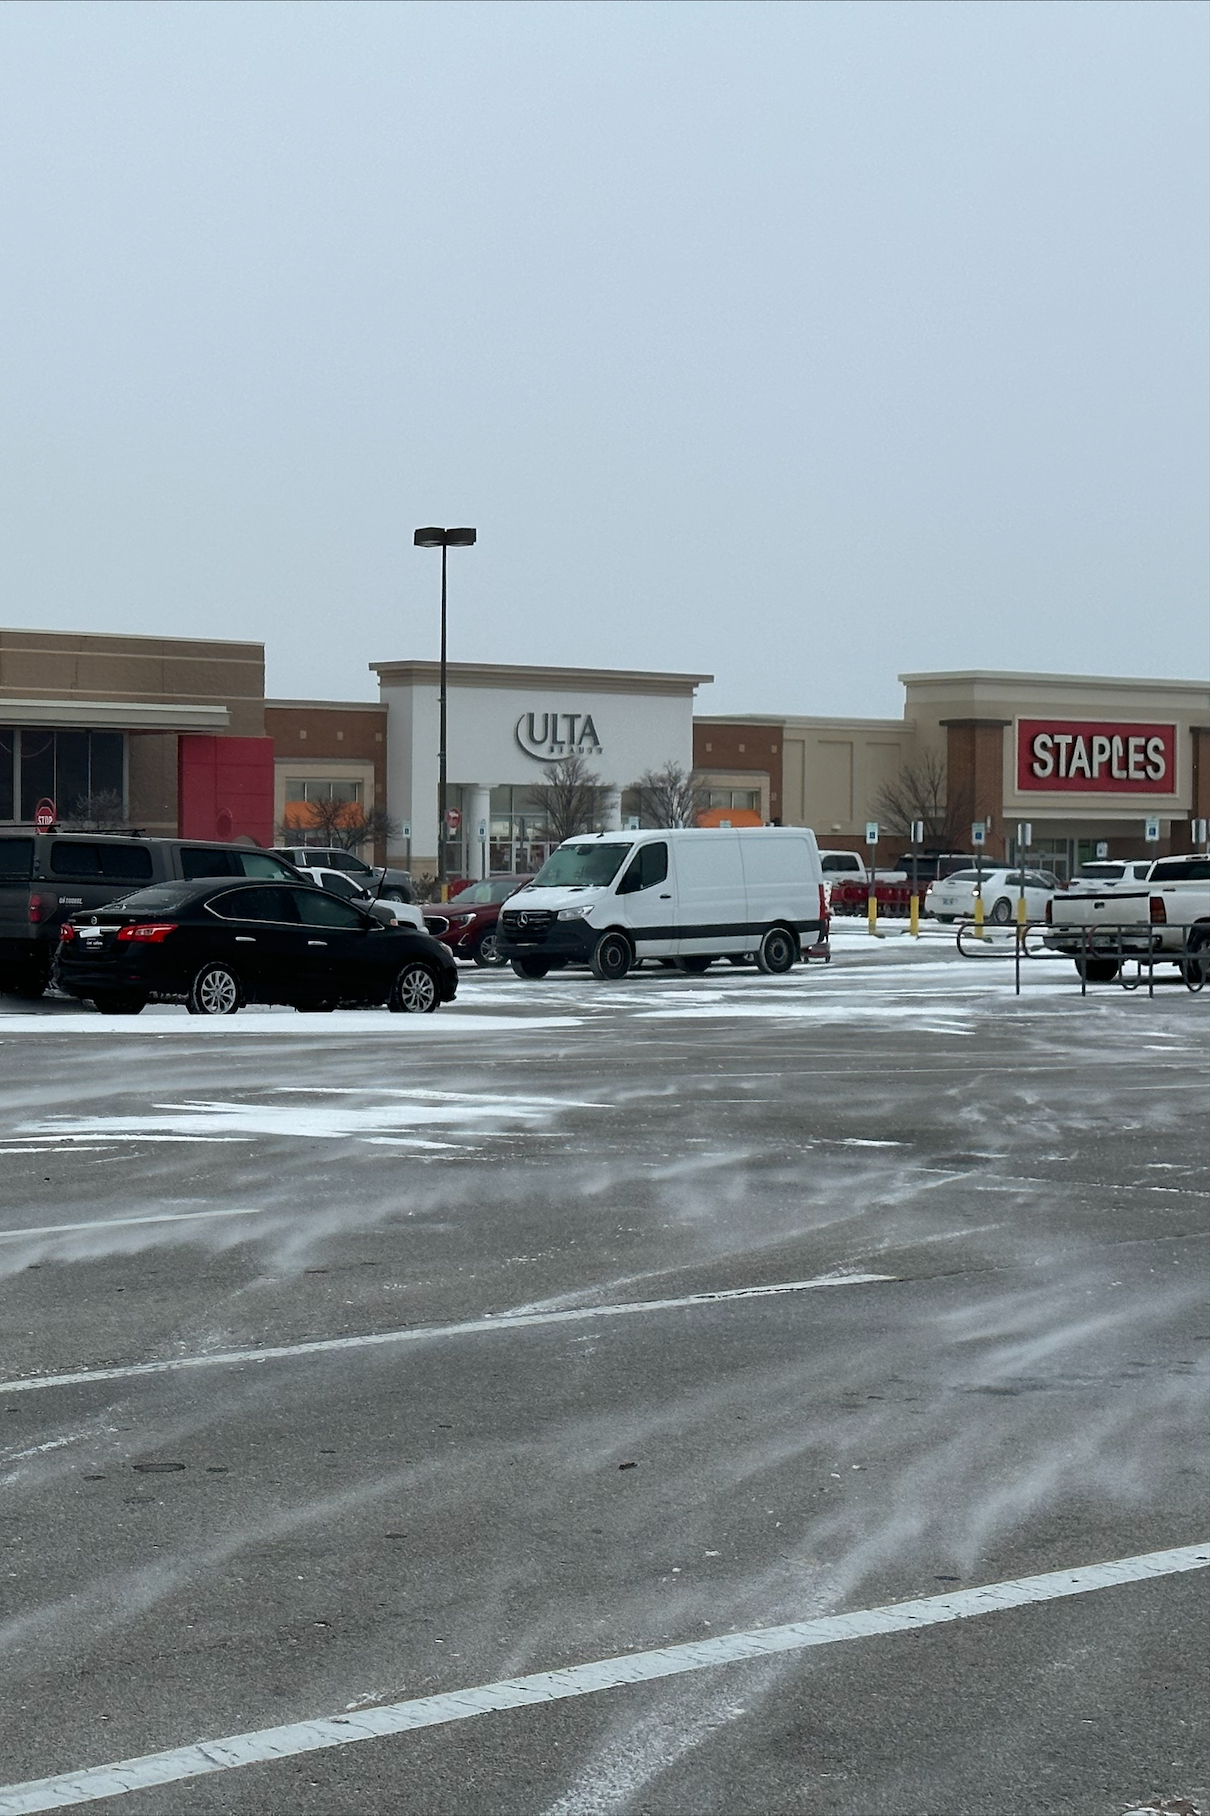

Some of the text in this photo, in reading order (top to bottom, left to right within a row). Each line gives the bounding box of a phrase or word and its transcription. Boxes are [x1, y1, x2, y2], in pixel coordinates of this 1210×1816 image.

[527, 712, 600, 745] ULTA
[1033, 733, 1166, 780] STAPLES
[37, 815, 54, 826] STOP
